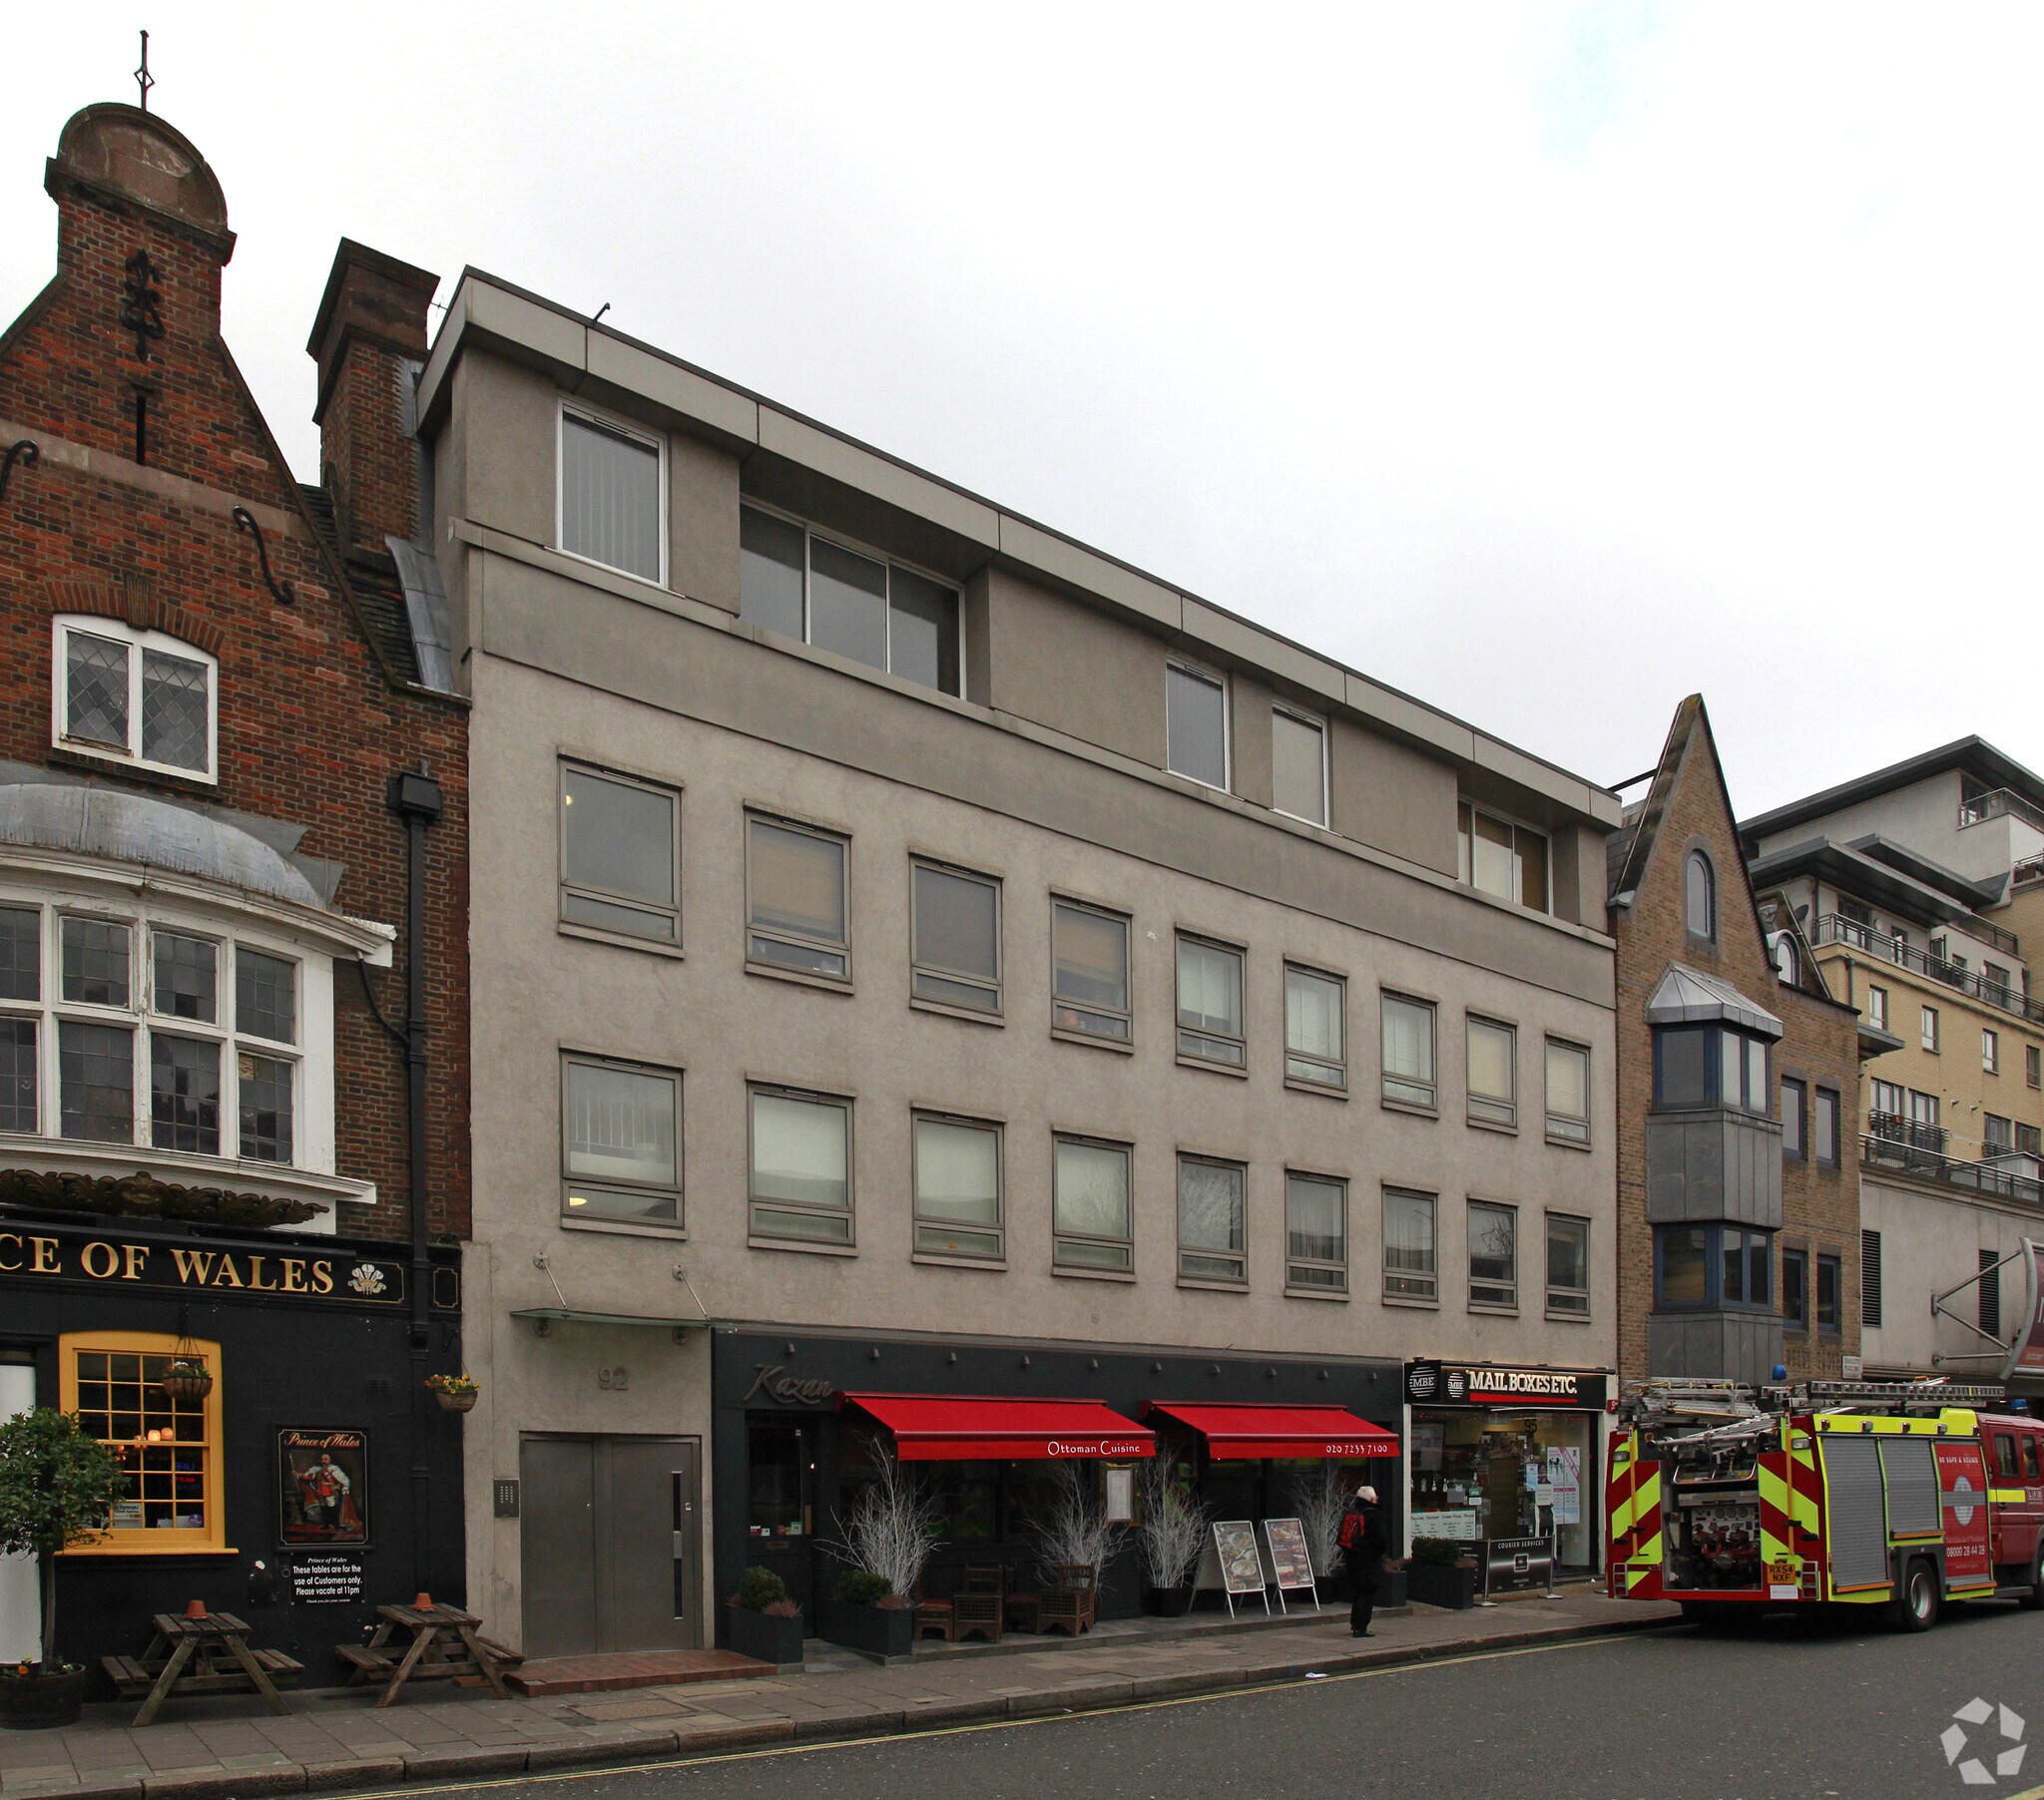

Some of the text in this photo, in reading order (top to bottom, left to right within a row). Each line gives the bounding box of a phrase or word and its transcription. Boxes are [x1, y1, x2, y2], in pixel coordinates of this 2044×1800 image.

[81, 1241, 150, 1279] OF
[170, 1248, 334, 1294] WALES
[598, 1366, 629, 1391] 92
[744, 1363, 834, 1406] Kazan
[1412, 1377, 1435, 1387] MBE
[1468, 1371, 1578, 1394] MAIL BOXES ETC.
[283, 1432, 360, 1448] Prince of Wales
[1047, 1440, 1141, 1456] Ottoman Cuisine
[1344, 1445, 1365, 1455] 7233
[1367, 1445, 1387, 1455] 7100
[1770, 1565, 1793, 1574] RX54
[347, 1575, 362, 1584] only.
[344, 1586, 360, 1595] 11pm
